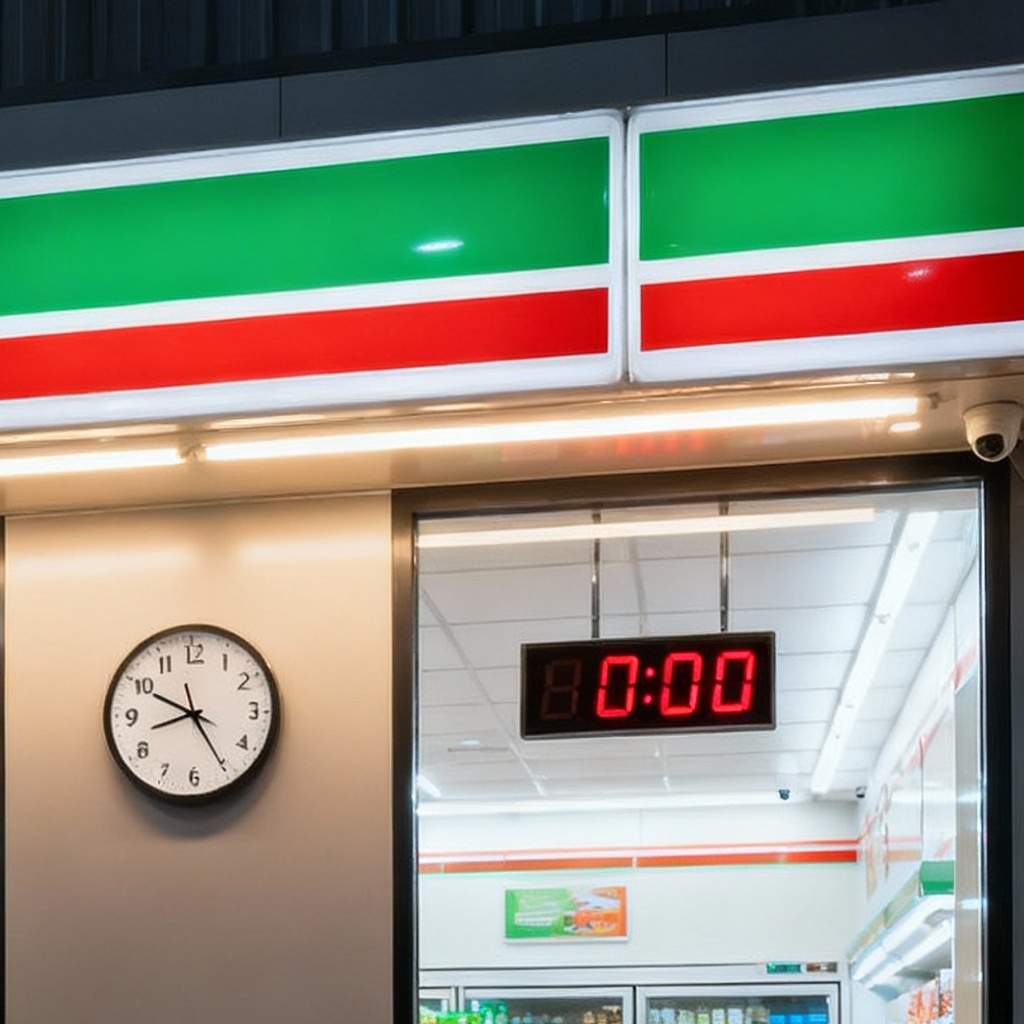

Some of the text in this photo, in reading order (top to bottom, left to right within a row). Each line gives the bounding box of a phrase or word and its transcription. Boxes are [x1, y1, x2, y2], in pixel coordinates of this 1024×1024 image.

[158, 654, 172, 675] 11
[134, 676, 154, 695] 10
[236, 671, 252, 691] 2
[596, 651, 756, 718] 0:00
[125, 708, 139, 728] 9
[248, 701, 259, 720] 3
[188, 766, 201, 787] 6
